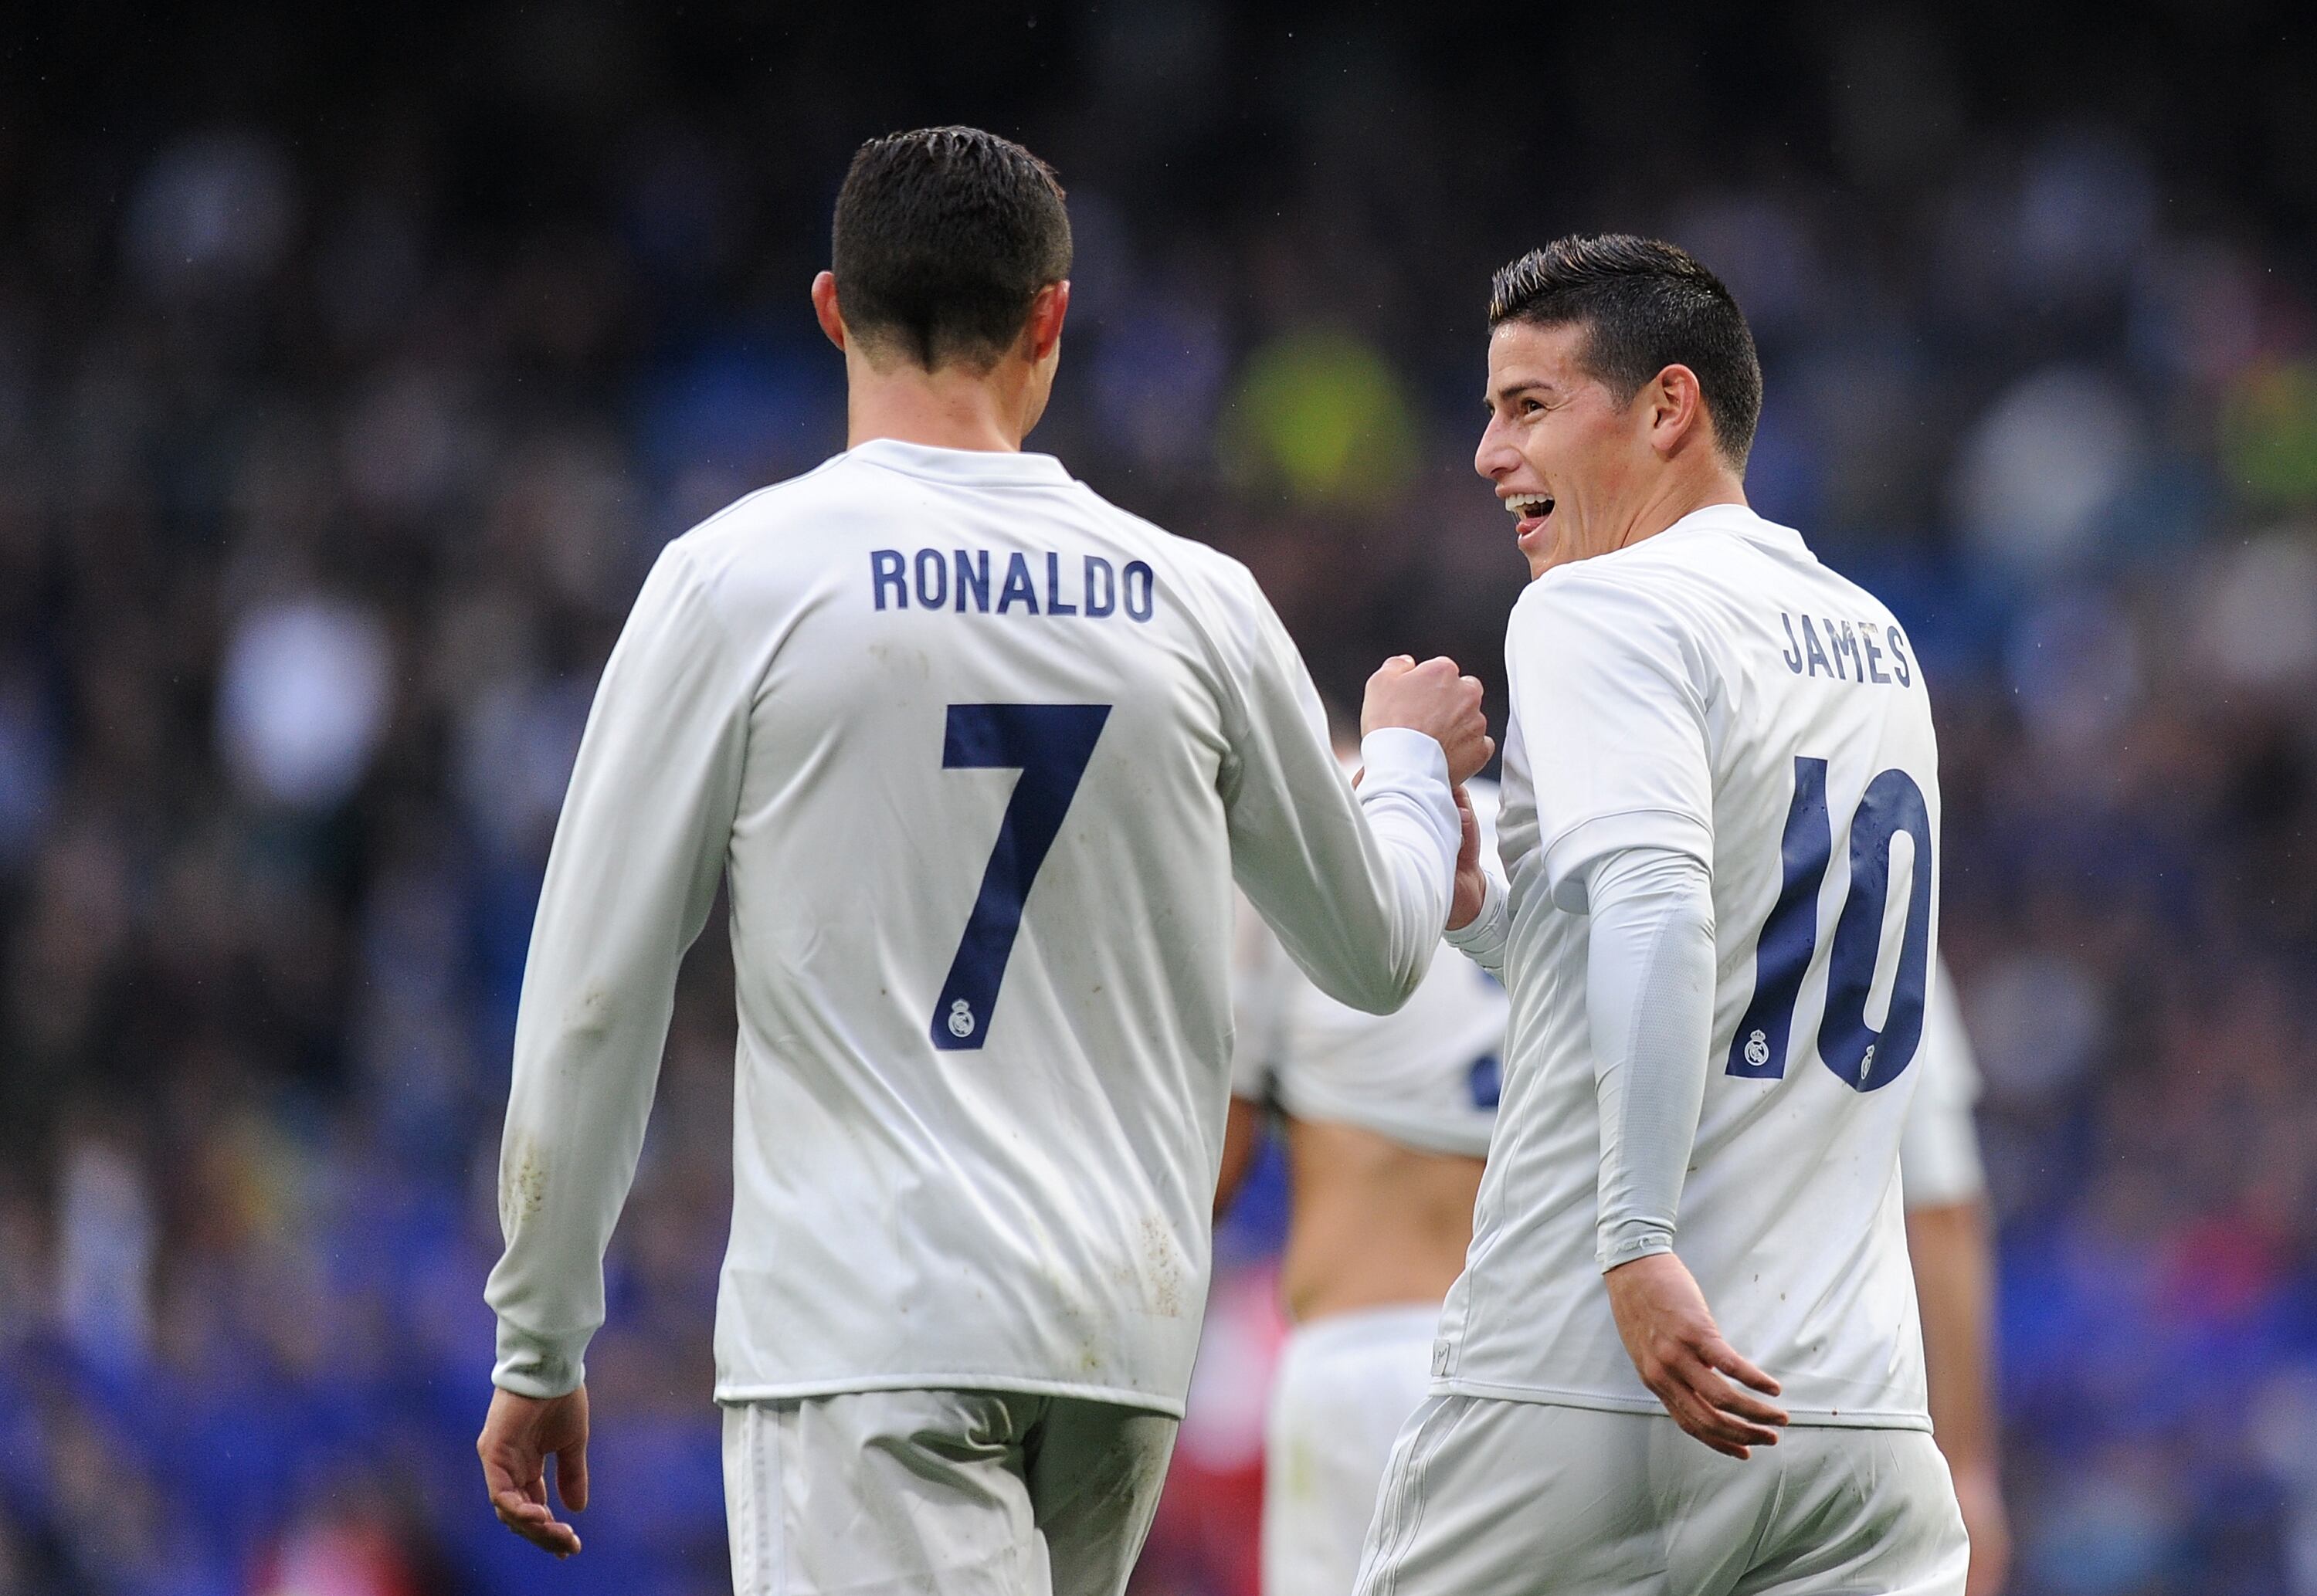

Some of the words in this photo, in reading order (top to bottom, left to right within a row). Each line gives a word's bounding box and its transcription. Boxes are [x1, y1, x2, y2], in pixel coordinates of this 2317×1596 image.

[870, 547, 1154, 623] RONALDO
[1781, 612, 1911, 688] JAMES
[930, 703, 1113, 1050] 7
[1725, 756, 1932, 1093] 10
